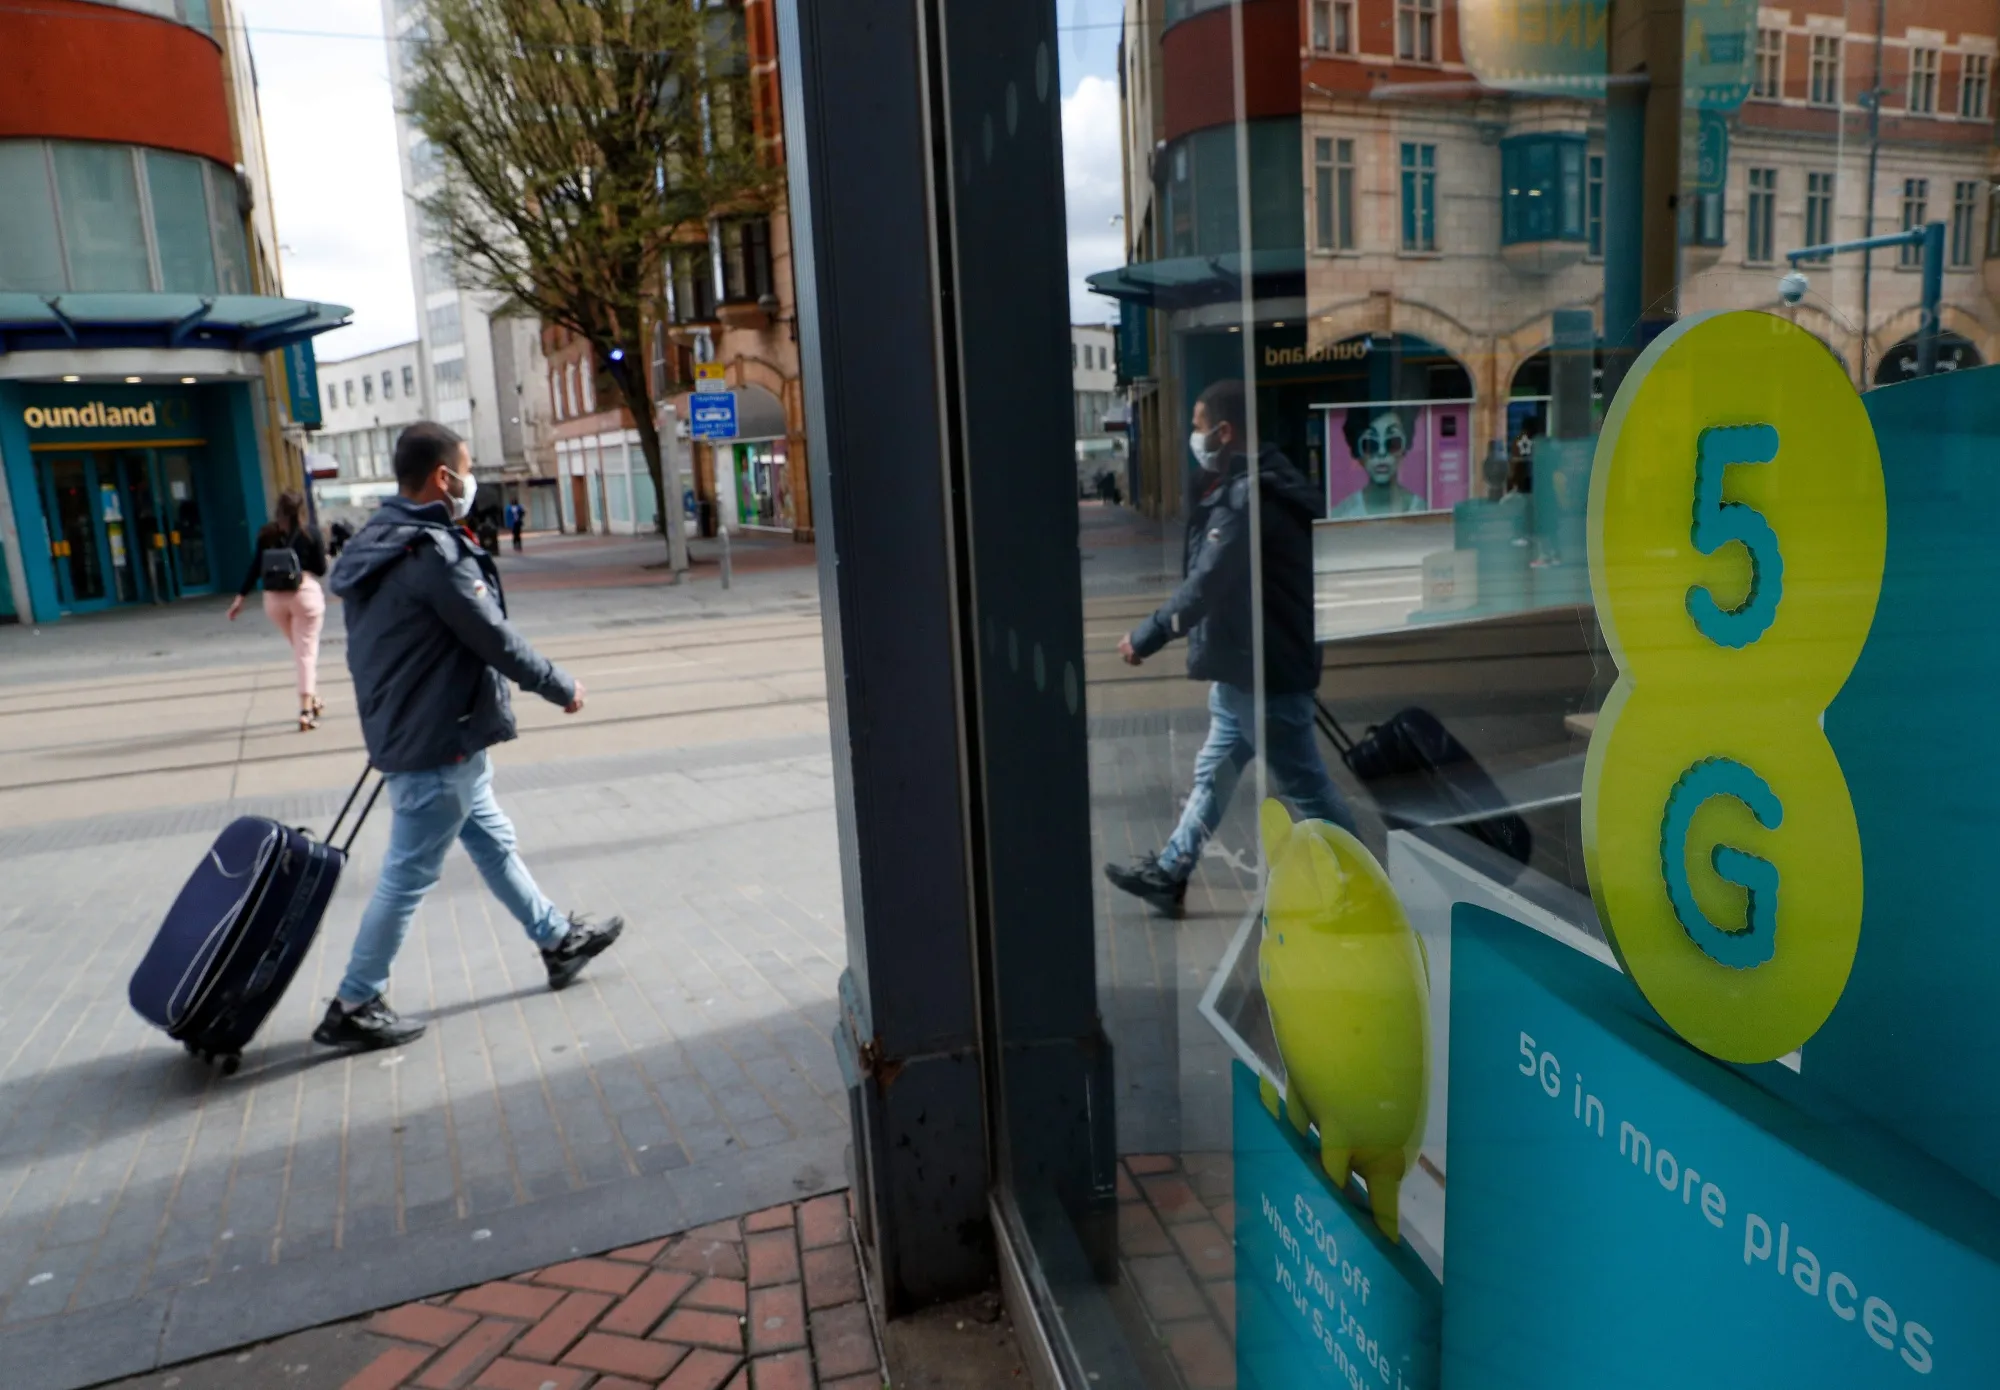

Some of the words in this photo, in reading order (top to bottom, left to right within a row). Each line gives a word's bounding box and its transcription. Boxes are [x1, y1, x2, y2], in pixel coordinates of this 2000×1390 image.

[23, 400, 157, 428] oundland
[1293, 1193, 1338, 1268] £300
[1341, 1259, 1371, 1307] off
[1518, 1031, 1561, 1098] 5G
[1574, 1072, 1605, 1138] in
[1619, 1120, 1727, 1229] more
[1743, 1212, 1935, 1375] places
[1274, 1253, 1309, 1316] your
[1305, 1254, 1336, 1311] you
[1339, 1298, 1391, 1386] trade
